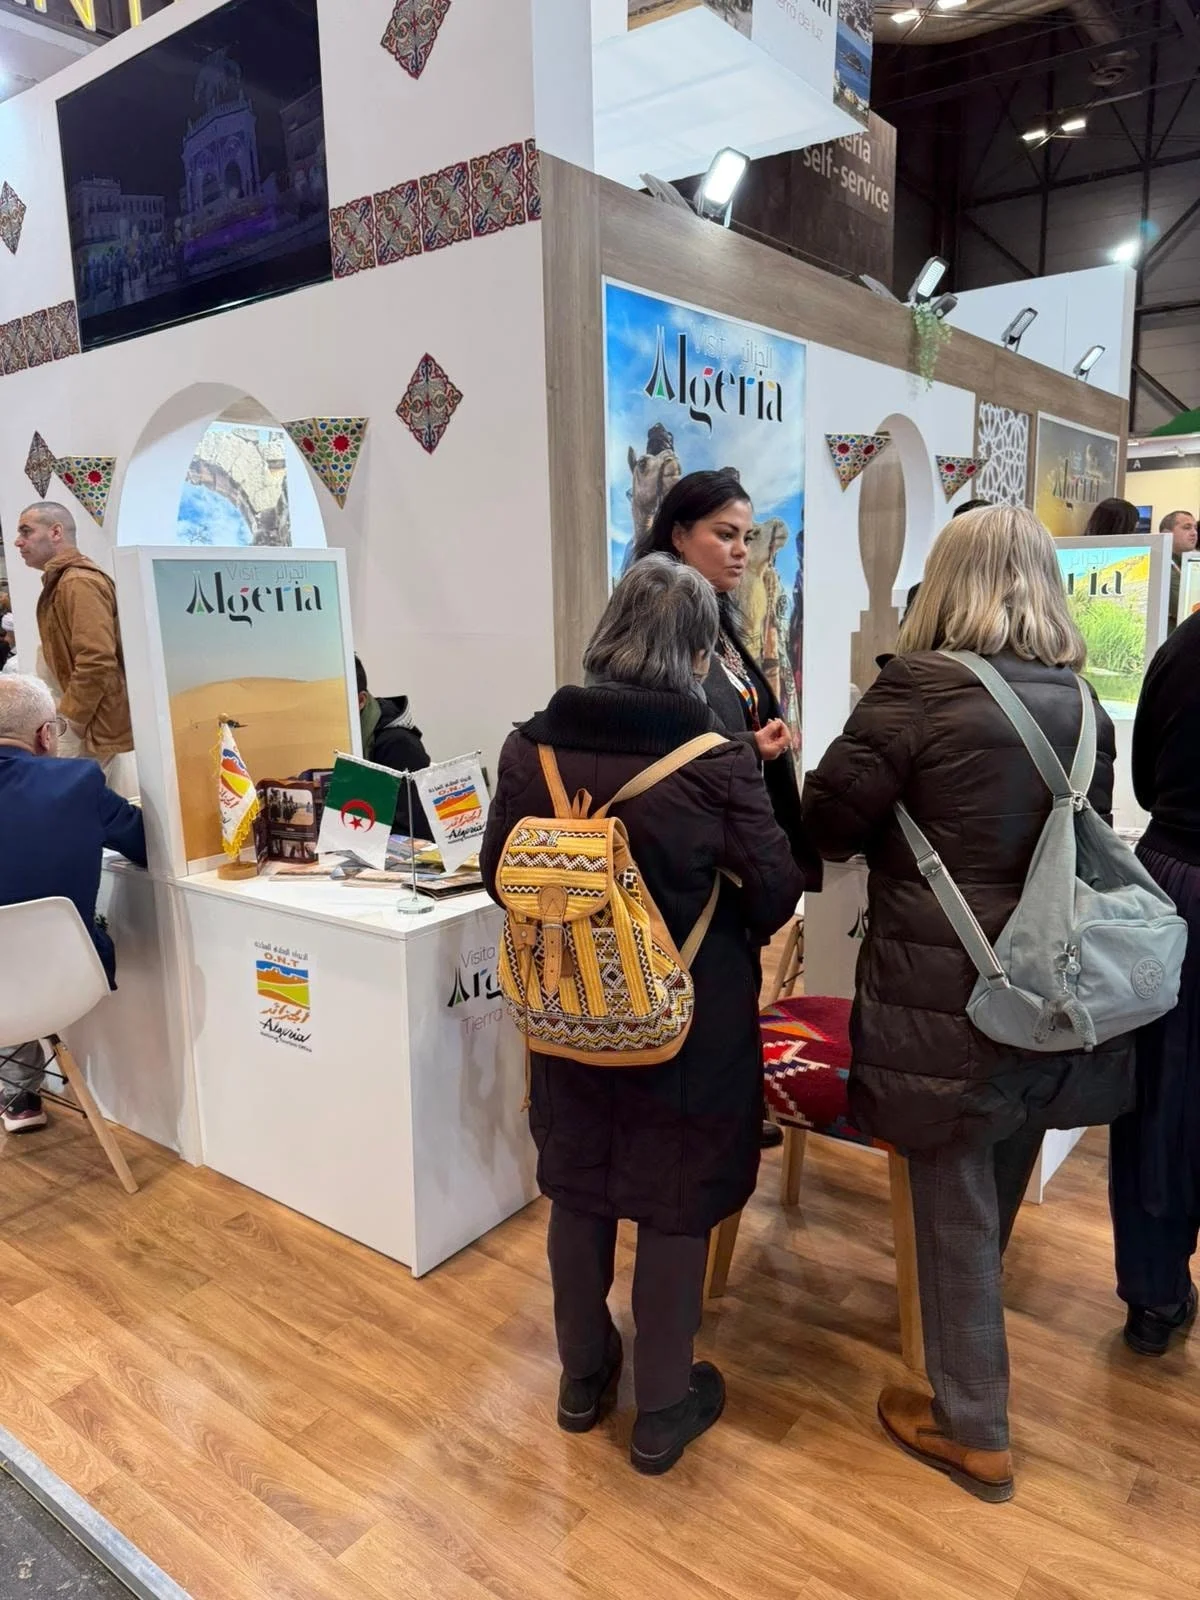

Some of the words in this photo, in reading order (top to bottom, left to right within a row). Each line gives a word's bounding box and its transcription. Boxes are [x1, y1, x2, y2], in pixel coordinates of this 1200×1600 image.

[803, 142, 890, 213] Self-service
[645, 324, 783, 433] Algeria
[226, 562, 258, 580] Visit
[1067, 566, 1122, 595] ria
[186, 571, 322, 628] Algeria
[264, 952, 300, 967] O.N.T
[461, 946, 496, 968] Visita
[447, 967, 504, 1008] Arg
[259, 1018, 312, 1042] Algeria
[462, 1008, 503, 1034] Tierra
